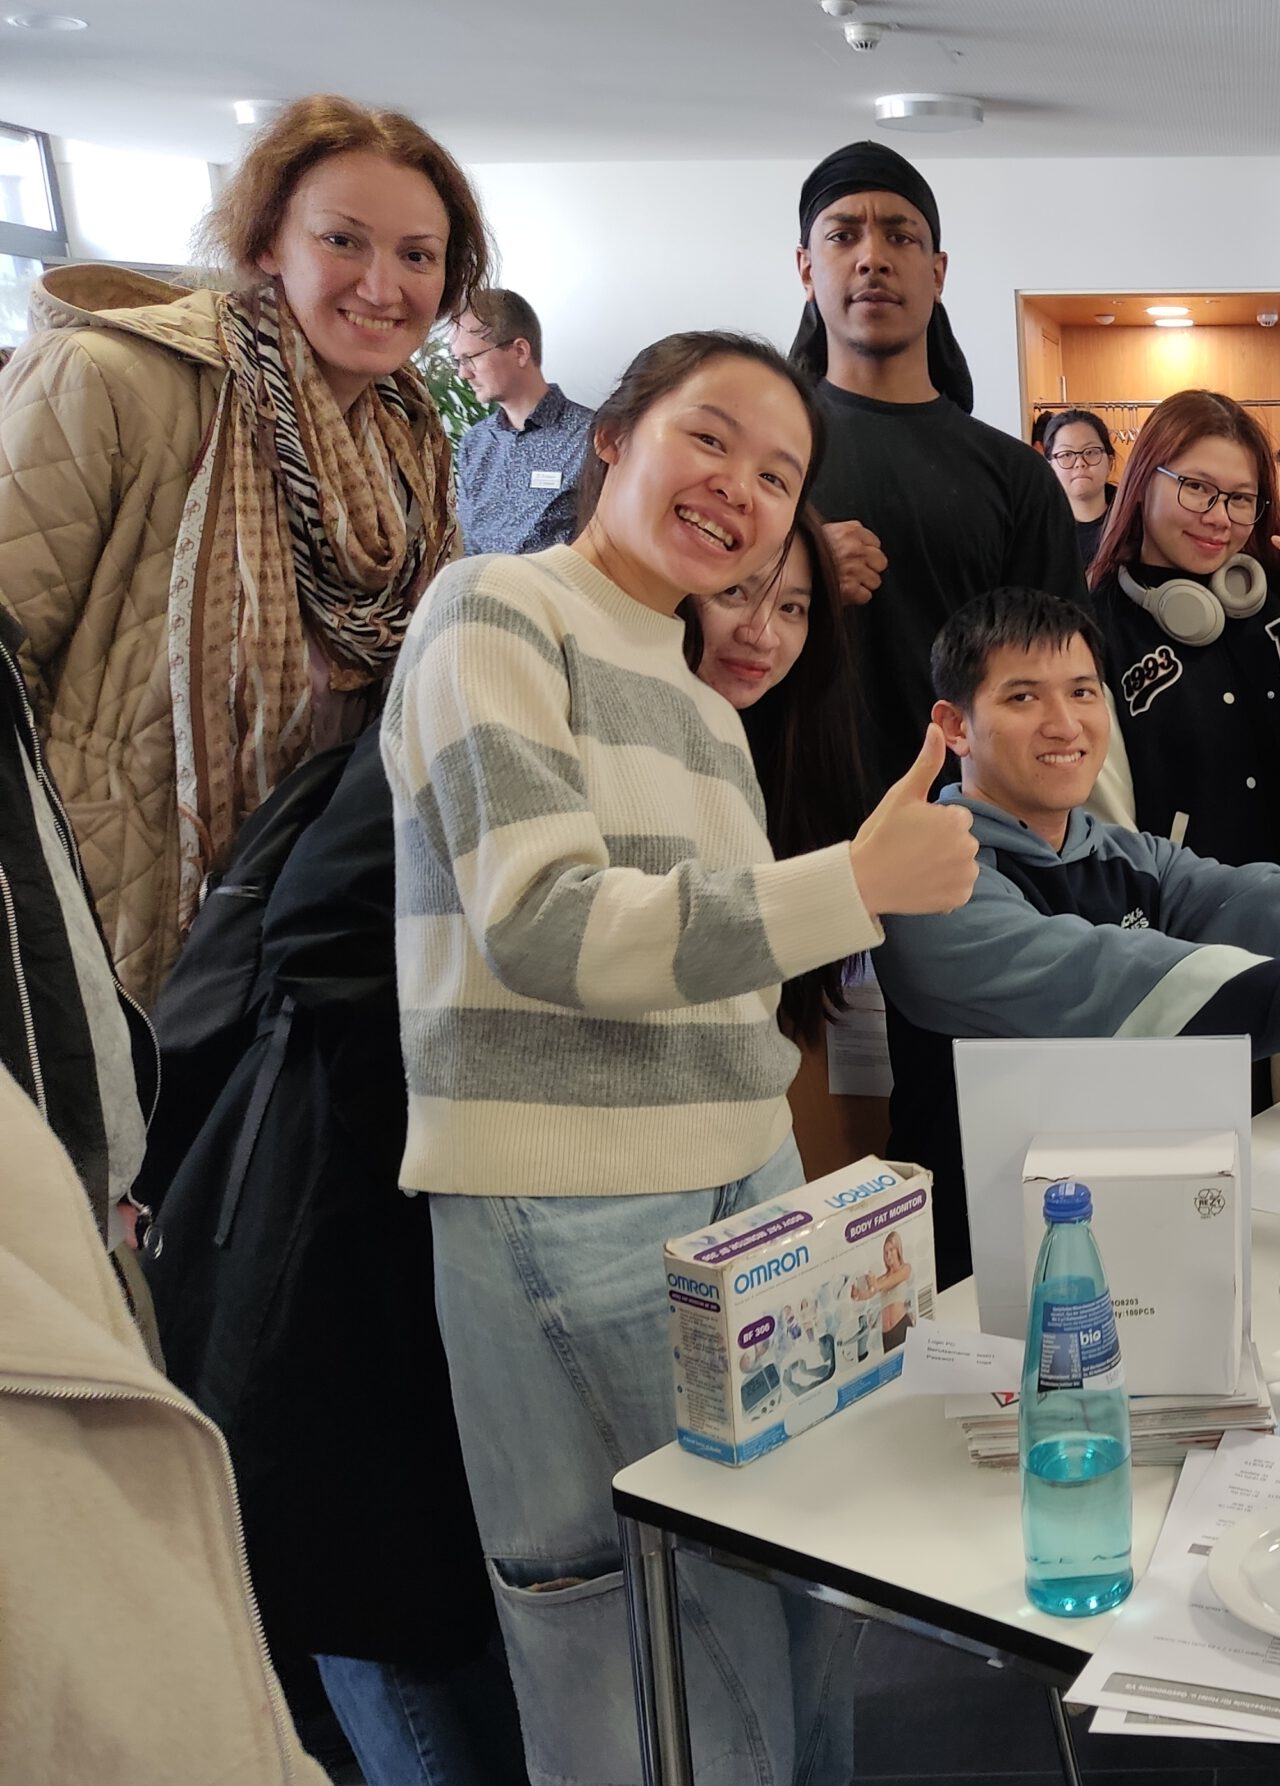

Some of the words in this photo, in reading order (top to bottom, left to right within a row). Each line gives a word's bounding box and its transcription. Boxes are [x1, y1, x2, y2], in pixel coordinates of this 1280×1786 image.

[1123, 647, 1176, 698] 1993
[823, 1174, 897, 1209] OMRON
[849, 1221, 873, 1238] BODY
[873, 1212, 889, 1228] FAT
[889, 1194, 923, 1219] MONITOR
[667, 1272, 720, 1300] OMRON
[734, 1245, 810, 1295] OMRON
[743, 1329, 754, 1344] BF
[1079, 1328, 1102, 1346] bio
